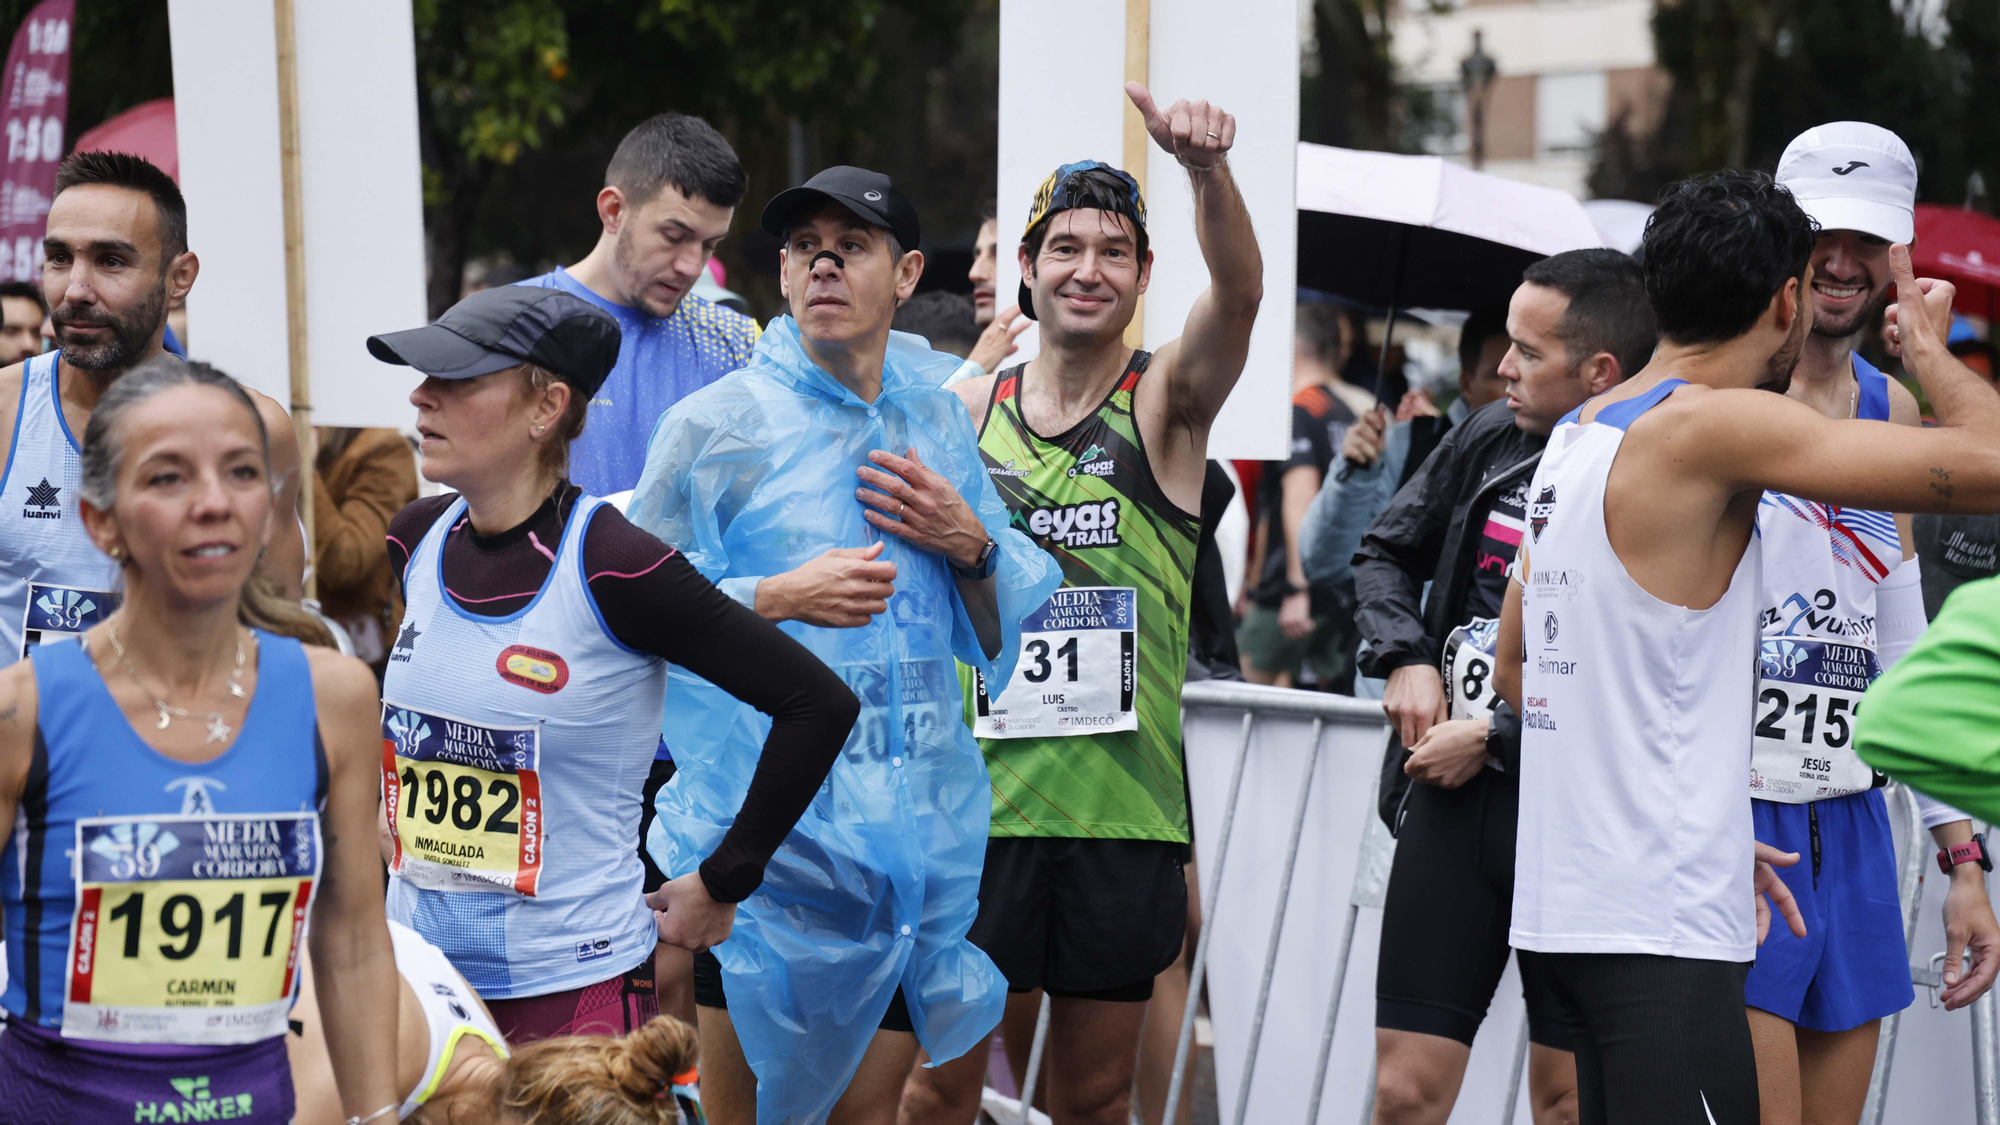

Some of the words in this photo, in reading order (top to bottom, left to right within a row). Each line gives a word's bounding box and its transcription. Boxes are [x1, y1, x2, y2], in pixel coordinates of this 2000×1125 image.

[6, 115, 63, 163] 1:50
[23, 509, 62, 519] luanvi
[1029, 500, 1117, 541] eyas
[1065, 529, 1118, 546] TRAIL
[1050, 592, 1101, 607] MEDIA
[1115, 592, 1127, 624] 2025
[46, 604, 83, 629] 39
[1043, 615, 1108, 629] CÓRDOBA
[1023, 637, 1079, 683] 31
[1765, 653, 1798, 678] 39
[1822, 644, 1867, 665] MEDIA
[1124, 660, 1133, 692] CAJÓN
[1462, 658, 1501, 711] 8
[1814, 671, 1871, 690] CÓRDOBA
[1043, 694, 1065, 705] LUIS
[1071, 716, 1115, 726] IMDECO
[1755, 688, 1860, 750] 215
[395, 724, 420, 755] 39
[444, 721, 495, 747] MEDIA
[514, 733, 527, 770] 2025
[387, 771, 397, 780] 2
[1799, 772, 1815, 780] REINA
[1801, 757, 1831, 772] JESÚS
[388, 784, 398, 836] CAJÓN
[401, 766, 519, 835] 1982
[526, 798, 537, 807] 2
[203, 820, 281, 844] MEDIA
[523, 811, 537, 864] CAJÓN
[415, 836, 485, 859] INMACULADA
[424, 853, 441, 864] RIVERA
[110, 842, 161, 879] 39
[83, 910, 96, 920] 2
[110, 891, 291, 961] 1917
[77, 923, 95, 975] CAJÓN
[166, 979, 237, 995] CARMEN
[632, 979, 654, 989] WONG
[134, 1092, 253, 1124] HANKER
